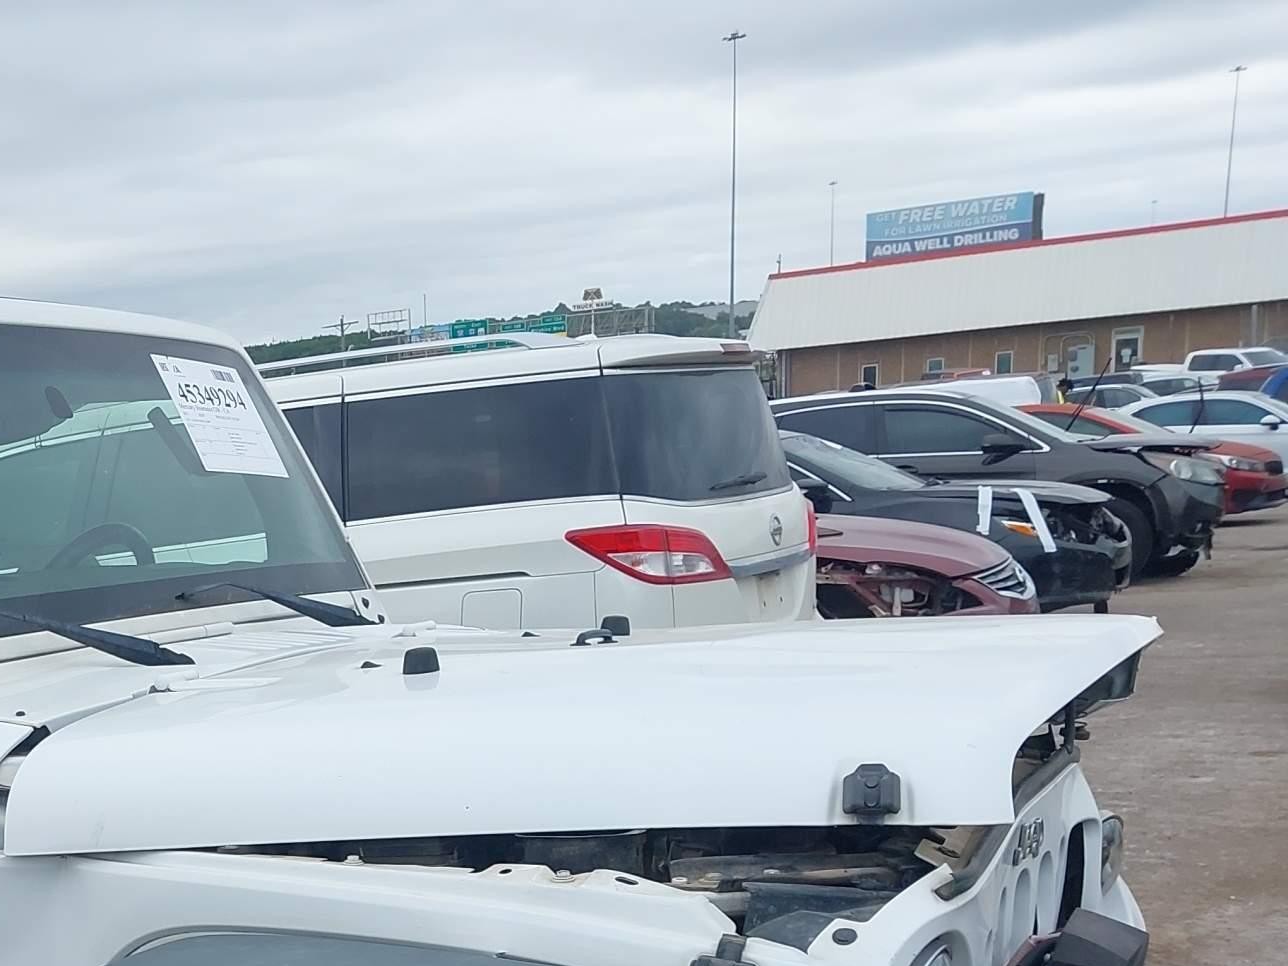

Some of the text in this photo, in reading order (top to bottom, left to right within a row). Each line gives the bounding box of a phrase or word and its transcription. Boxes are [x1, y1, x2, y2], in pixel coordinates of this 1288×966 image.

[898, 205, 946, 224] FREE
[951, 196, 1018, 217] WATER
[884, 214, 1008, 237] FOR LAWN IRRIGATION
[872, 228, 1020, 257] AQUA WELL DRILLING
[178, 383, 247, 410] 45349294
